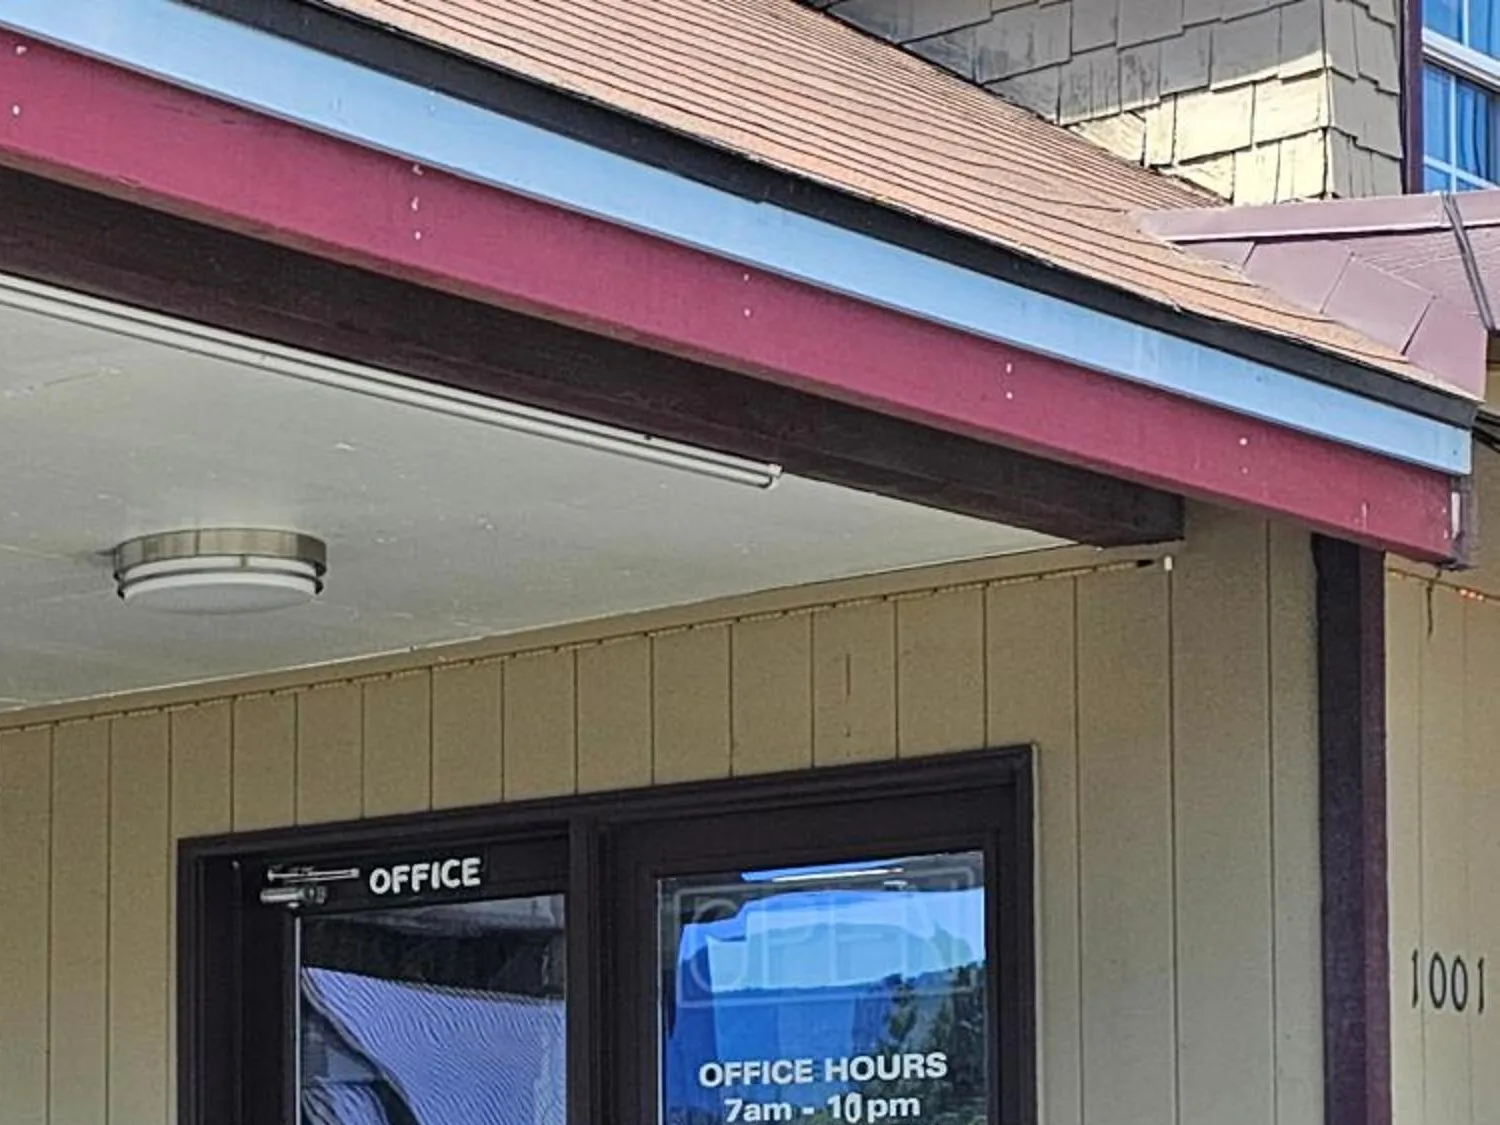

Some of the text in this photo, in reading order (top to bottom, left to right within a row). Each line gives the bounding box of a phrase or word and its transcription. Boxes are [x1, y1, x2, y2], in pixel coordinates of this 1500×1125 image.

[369, 857, 482, 895] OFFICE
[1411, 948, 1485, 1015] 1001
[699, 1052, 949, 1088] OFFICE HOURS
[724, 1098, 793, 1123] 7am
[827, 1093, 921, 1124] 10pm
